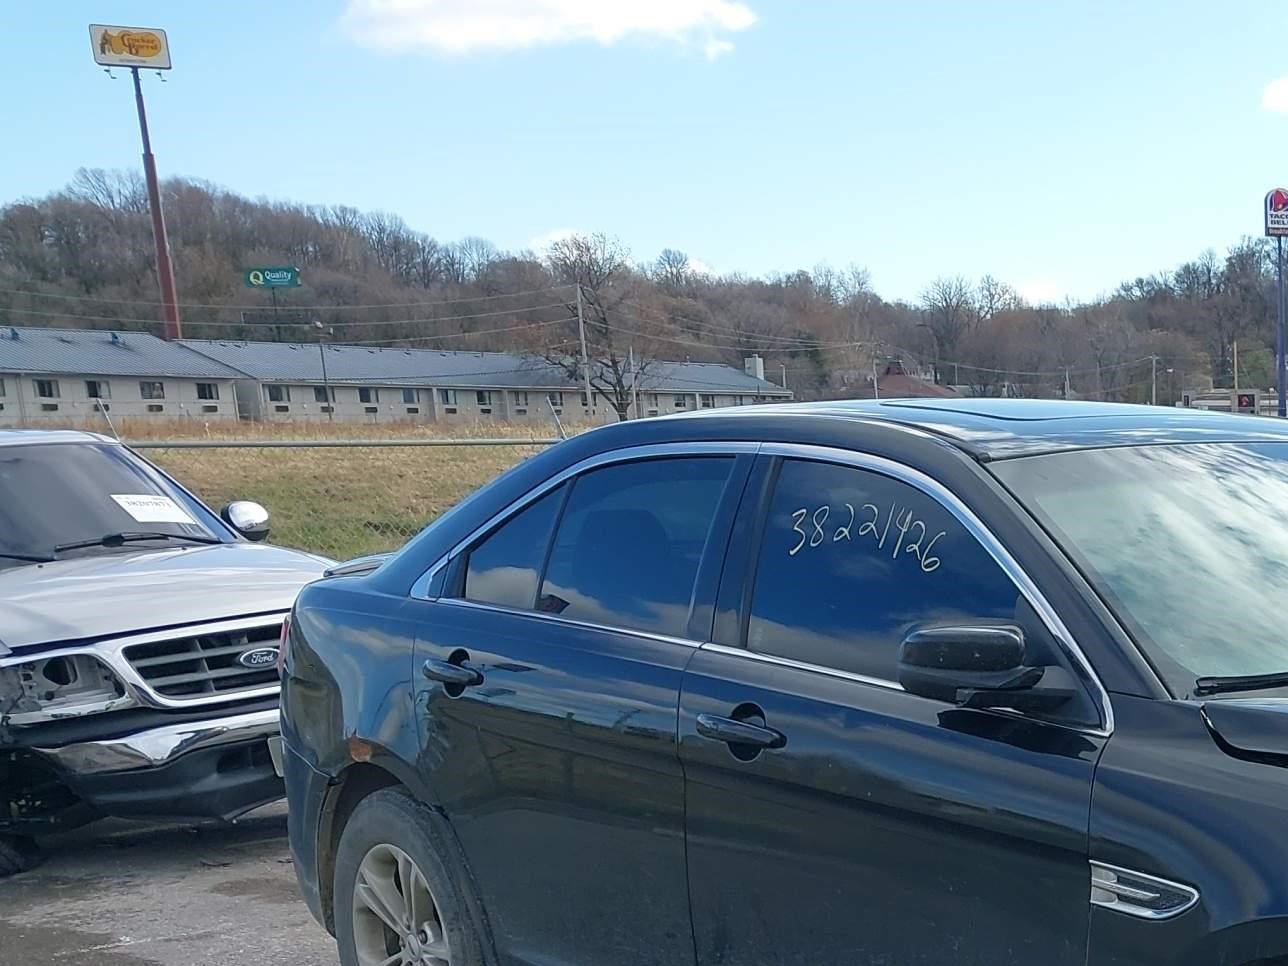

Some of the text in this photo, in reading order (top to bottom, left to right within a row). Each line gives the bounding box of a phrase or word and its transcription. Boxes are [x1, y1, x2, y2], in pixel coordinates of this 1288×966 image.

[264, 271, 292, 280] Quality
[789, 501, 947, 572] 38221426
[251, 651, 275, 664] Ford
